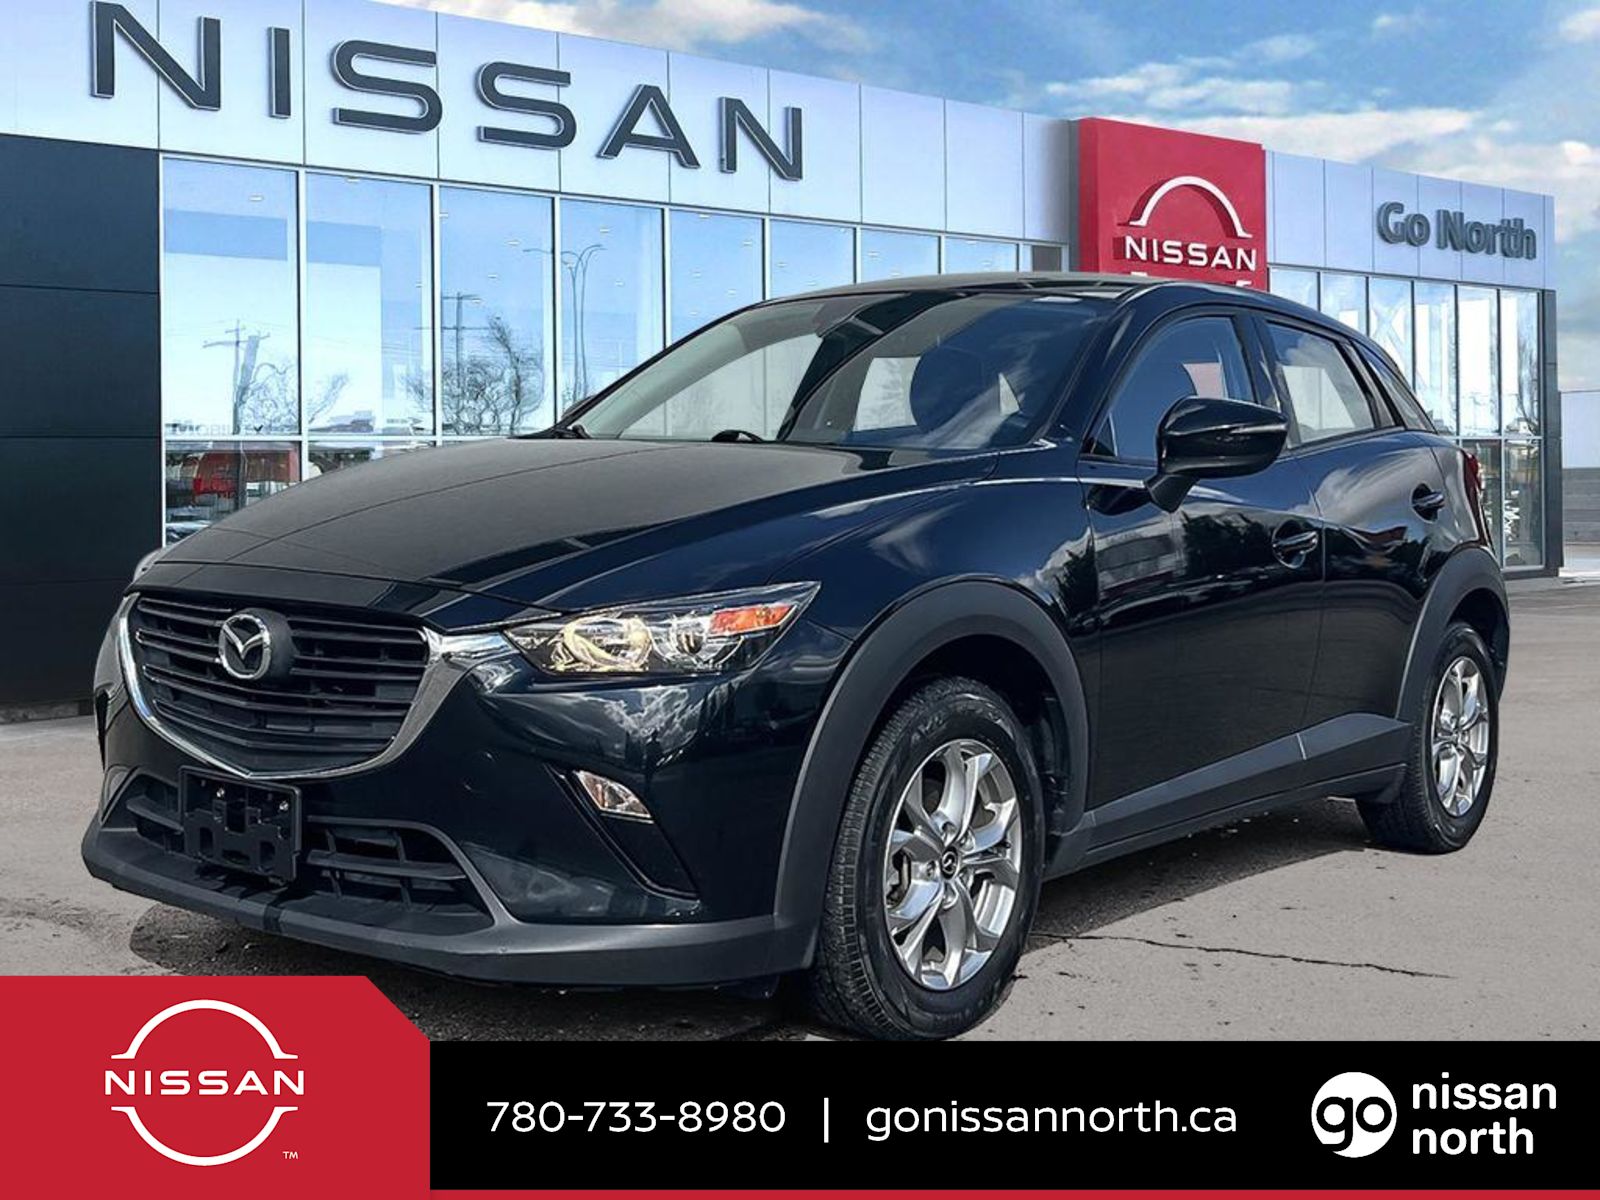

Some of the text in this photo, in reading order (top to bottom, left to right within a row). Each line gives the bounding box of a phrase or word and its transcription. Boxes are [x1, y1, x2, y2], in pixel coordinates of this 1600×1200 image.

[89, 0, 804, 181] NISSAN
[1124, 235, 1257, 271] NISSAN
[1377, 201, 1538, 261] Go North
